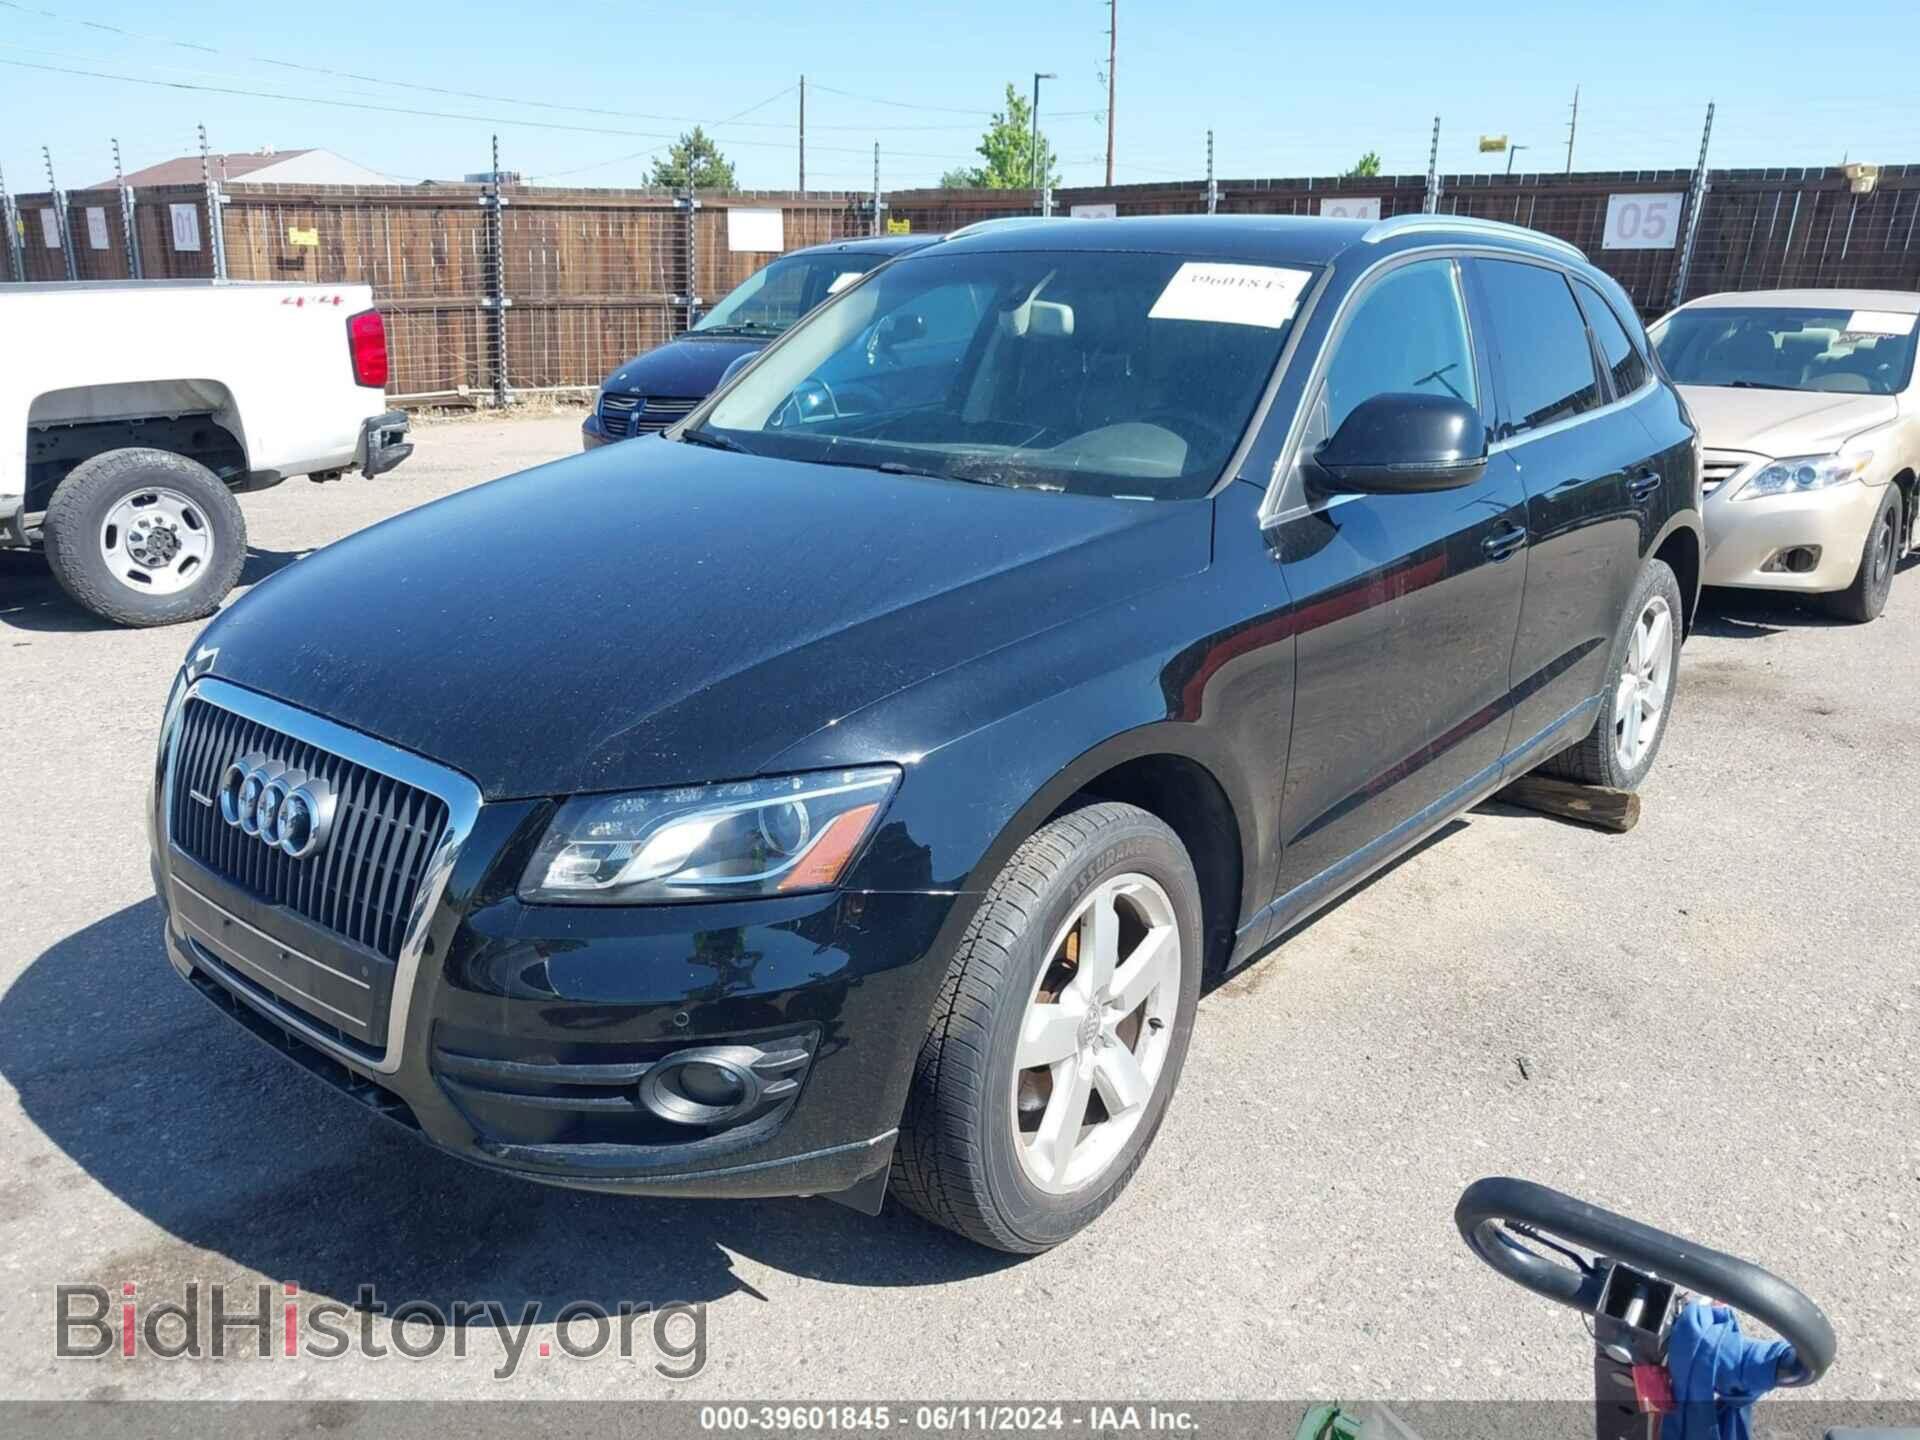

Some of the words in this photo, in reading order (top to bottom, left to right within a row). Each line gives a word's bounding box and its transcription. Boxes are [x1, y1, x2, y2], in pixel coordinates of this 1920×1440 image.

[175, 211, 195, 243] 01
[1616, 202, 1668, 240] 05
[280, 294, 344, 309] 44
